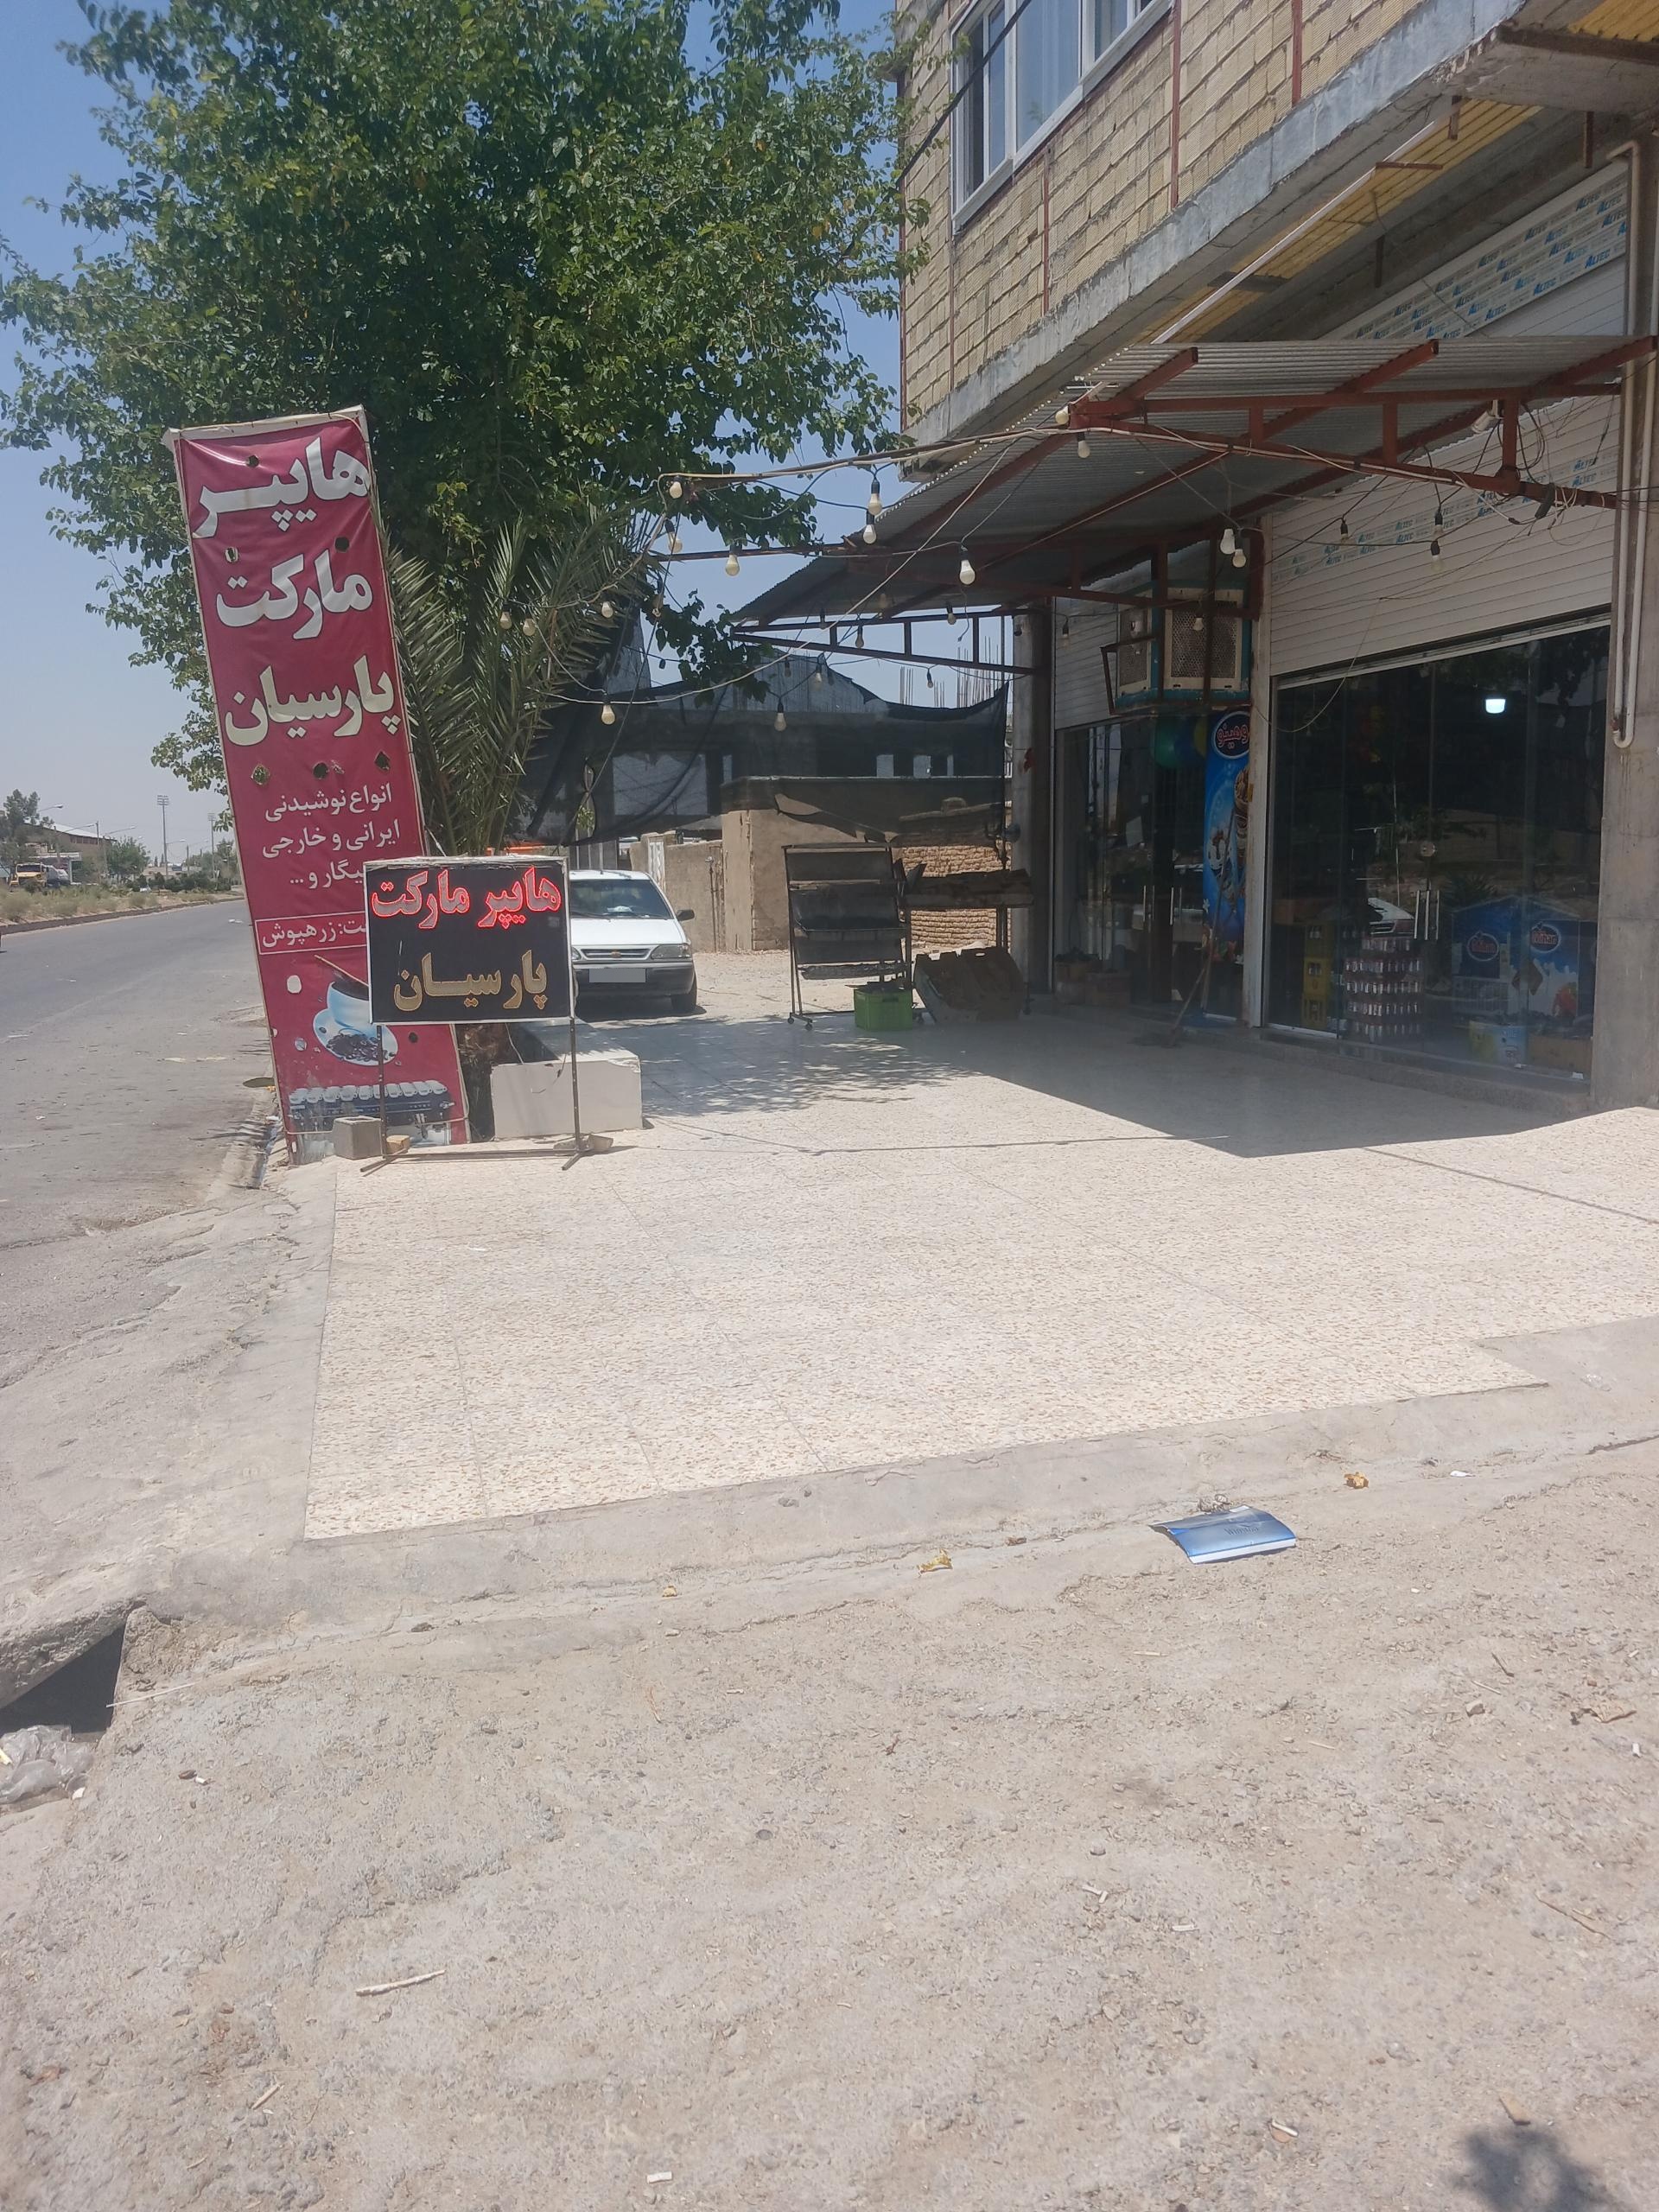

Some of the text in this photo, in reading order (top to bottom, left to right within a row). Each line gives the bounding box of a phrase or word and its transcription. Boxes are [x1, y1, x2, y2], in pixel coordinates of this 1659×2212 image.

[1596, 194, 1624, 215] ALTEC
[1585, 249, 1611, 269] ALTEC
[1533, 277, 1557, 296] ALTEC
[1484, 303, 1507, 321] ALTEC
[193, 436, 372, 538] هایپر
[216, 549, 373, 640] مارکت
[225, 655, 401, 746] پارسیان
[265, 782, 392, 822] انواع نوشیدنی
[262, 819, 400, 858] ایرانی و خارجی
[308, 871, 319, 889] و
[322, 859, 364, 888] یگار
[372, 866, 562, 930] هایپر مارکت
[393, 950, 549, 1012] پارسیان
